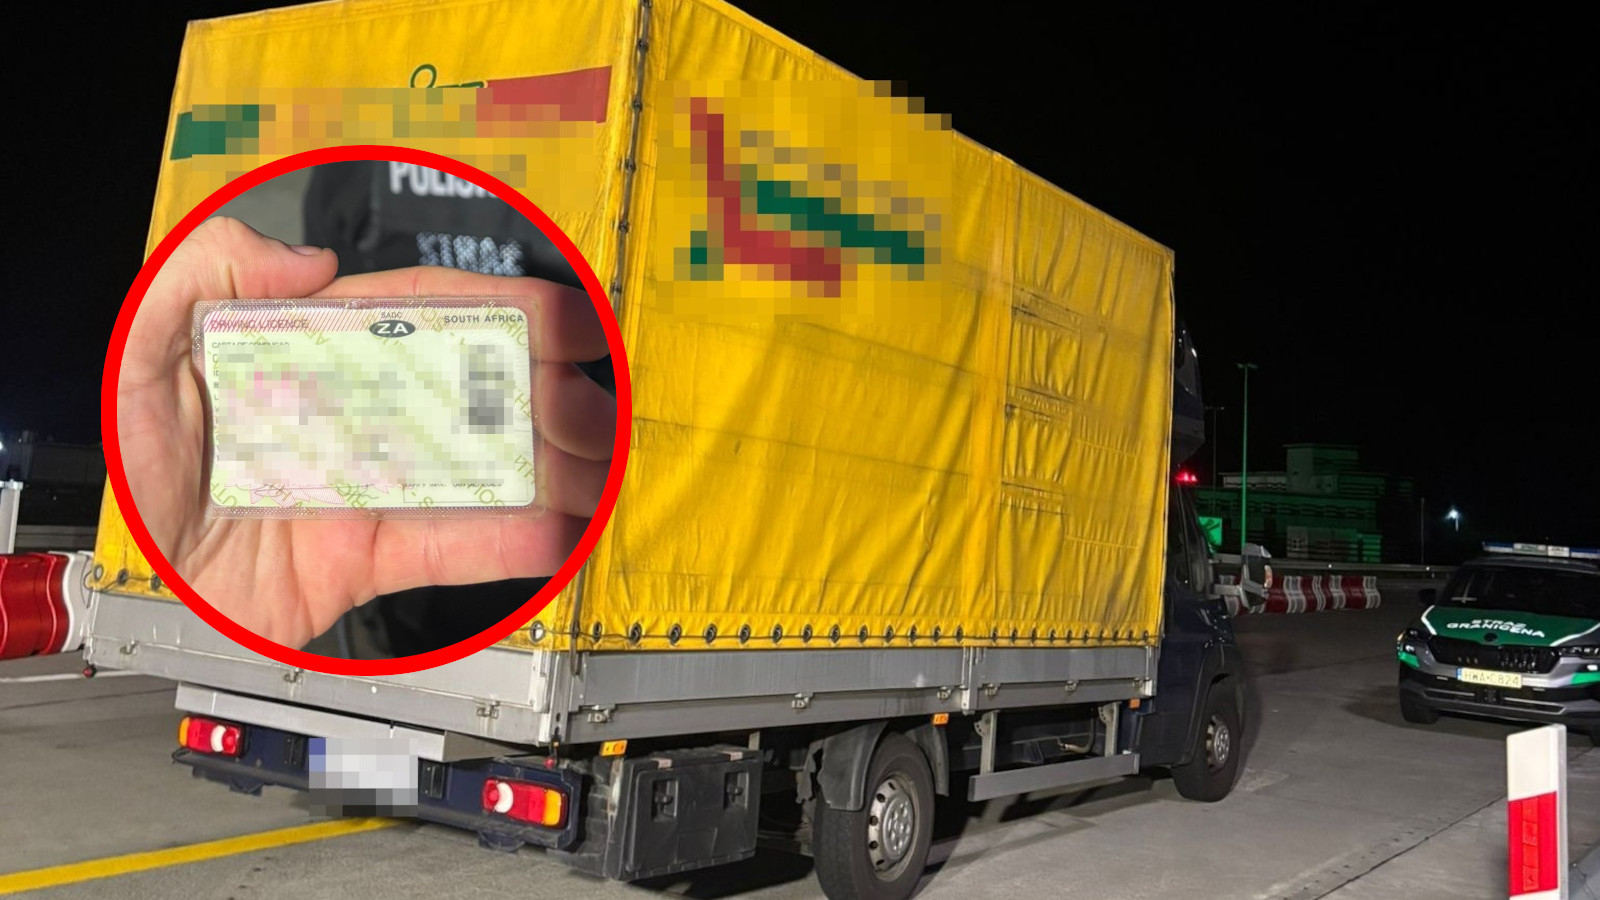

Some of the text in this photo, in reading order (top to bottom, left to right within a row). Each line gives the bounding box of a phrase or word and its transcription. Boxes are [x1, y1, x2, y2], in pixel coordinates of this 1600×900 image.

[380, 311, 403, 319] SADC
[444, 314, 524, 324] SOUTH AFRICA
[210, 318, 309, 330] DRIVING LICENCE
[377, 322, 409, 334] ZA
